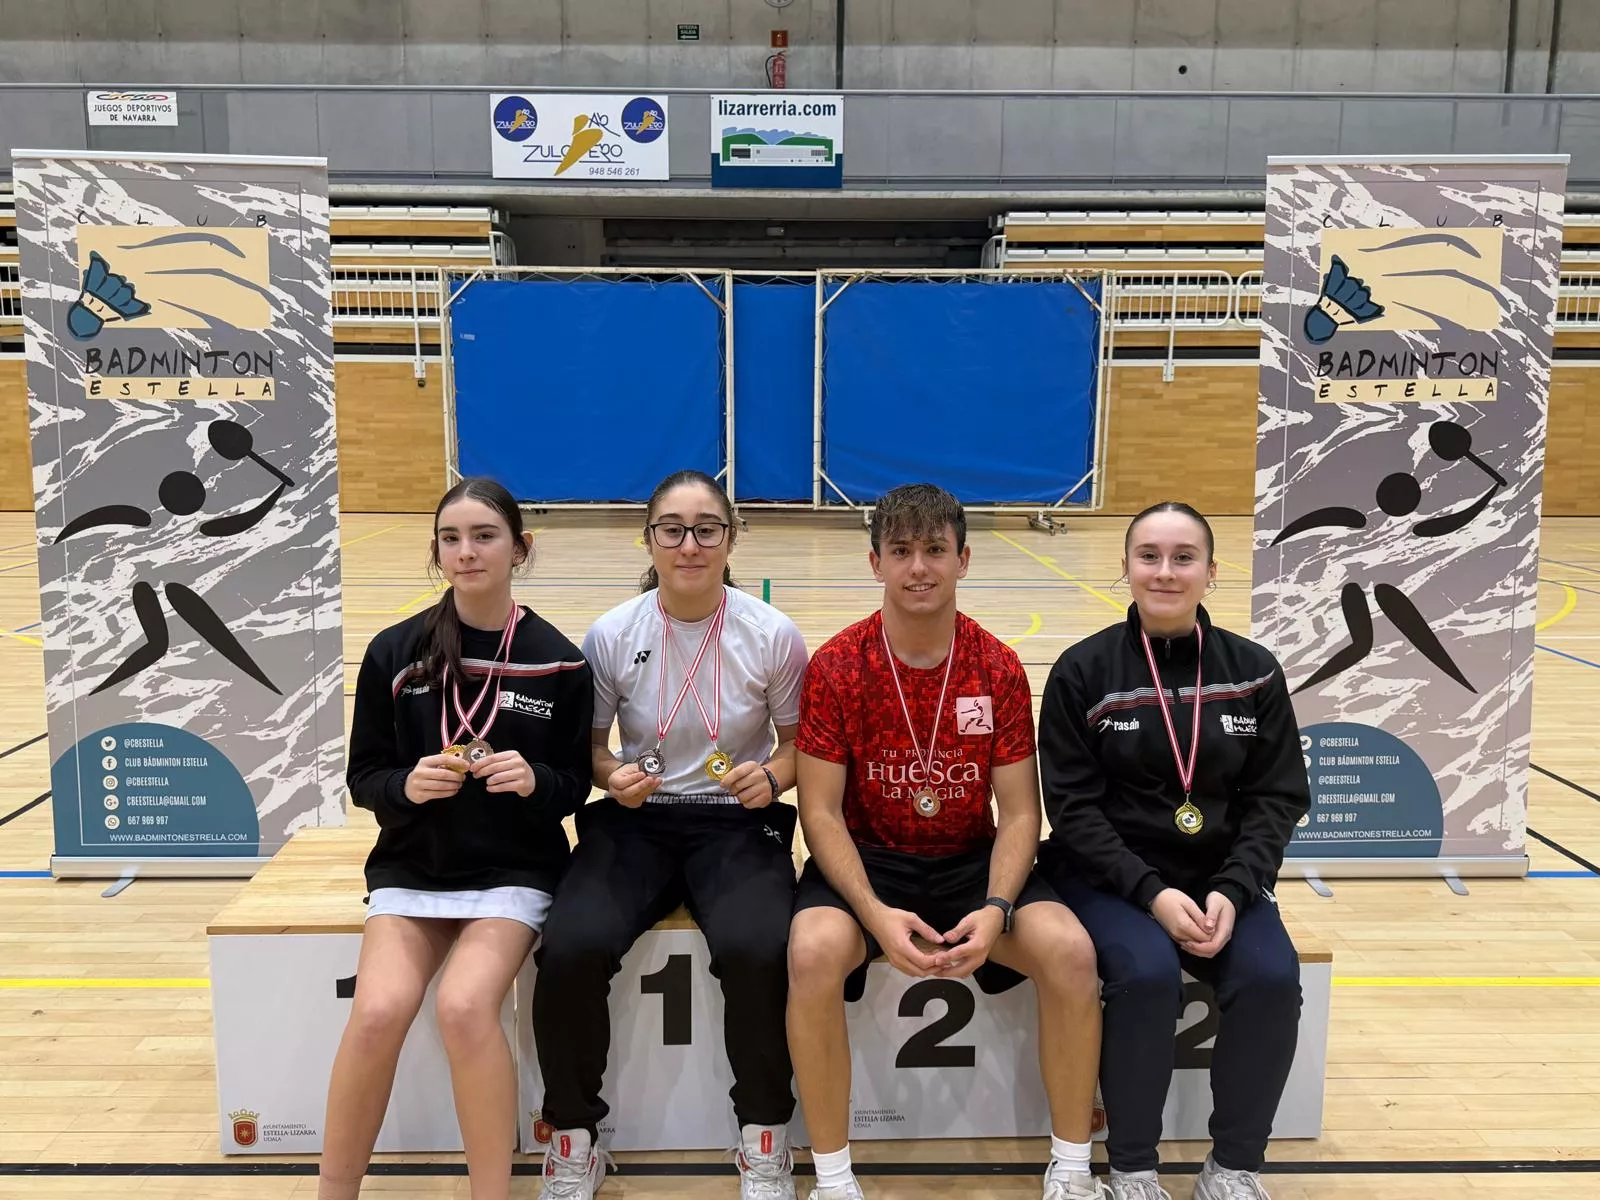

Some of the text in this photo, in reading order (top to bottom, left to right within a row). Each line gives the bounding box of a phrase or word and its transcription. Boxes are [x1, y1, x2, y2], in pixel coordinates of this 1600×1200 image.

[94, 104, 172, 112] JUEGOS DEPORTIVOS
[718, 100, 836, 116] lizarrerria.com
[123, 114, 157, 122] NAVARRA
[588, 167, 640, 176] 948 546 261
[77, 211, 267, 225] CLUB
[1322, 214, 1504, 228] CLUB
[85, 346, 274, 375] BADMINTON
[1316, 350, 1498, 378] BADMINTON
[90, 380, 272, 397] ESTELLA
[1318, 382, 1495, 398] ESTELLA
[124, 738, 164, 749] @CBESTELLA
[1319, 737, 1359, 747] @CBESTELLA
[124, 758, 142, 767] CLUB
[183, 757, 208, 767] ESTELLA
[1319, 756, 1336, 766] CLUB
[1375, 755, 1400, 765] ESTELLA
[125, 776, 169, 787] @CBEESTELLA
[1318, 775, 1361, 785] @CBEESTELLA
[126, 795, 207, 806] CBEESTELLA@GMAIL.COM
[1317, 793, 1395, 804] CBEESTELLA@GMAIL.COM
[127, 816, 139, 825] 667
[109, 833, 248, 842] WWW.BADMINTONESTRELLA.COM
[1297, 829, 1432, 839] WWW.BADMINTONESTRELLA.COM
[640, 954, 692, 1045] 1
[895, 978, 975, 1068] 2
